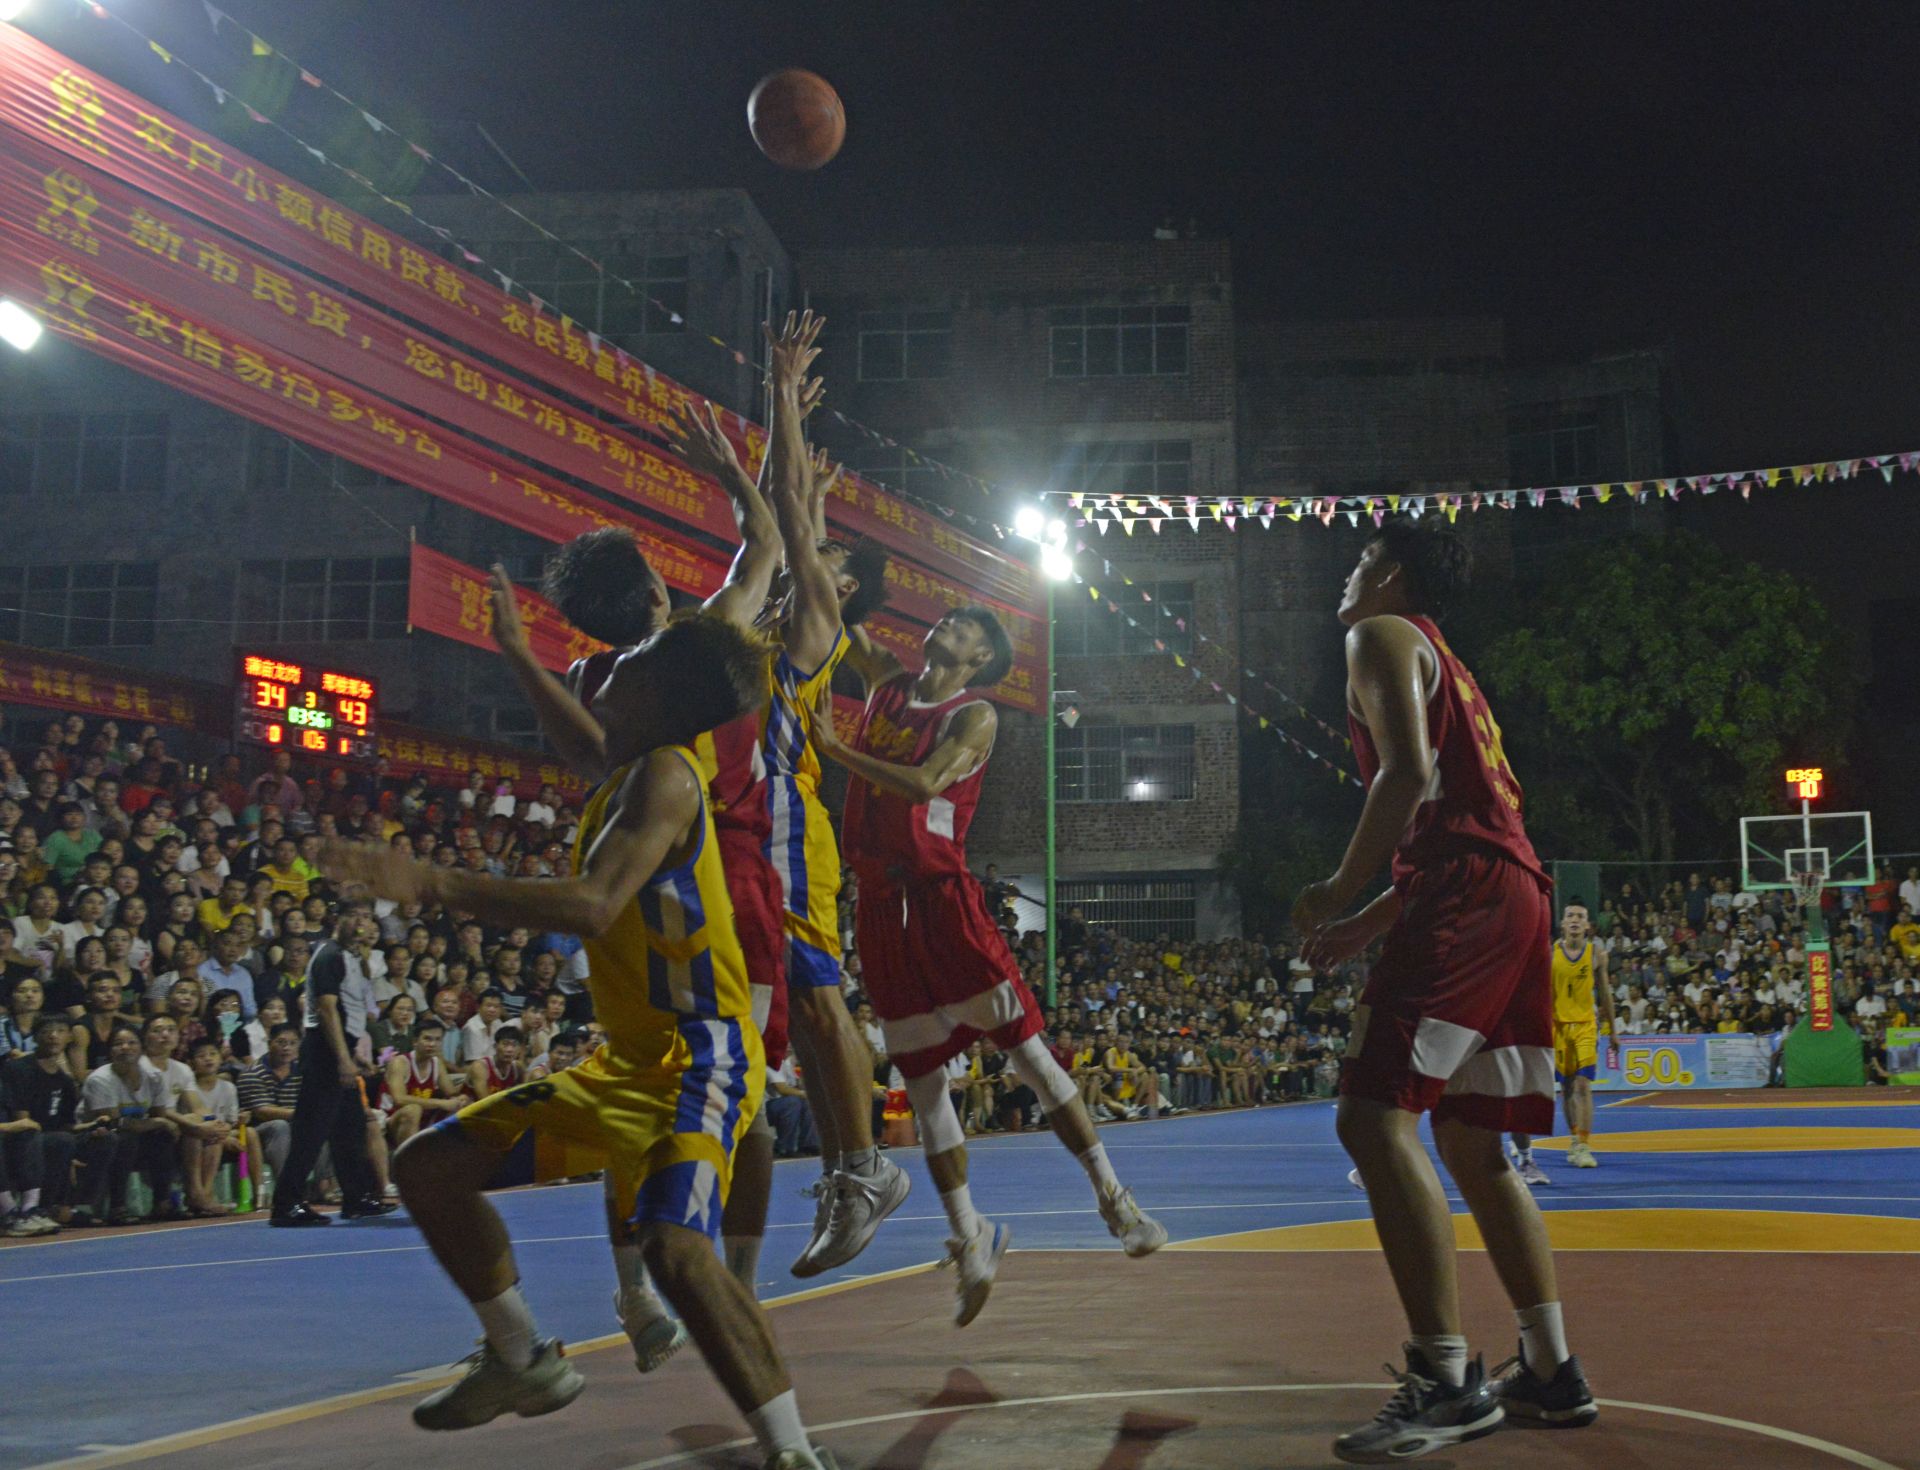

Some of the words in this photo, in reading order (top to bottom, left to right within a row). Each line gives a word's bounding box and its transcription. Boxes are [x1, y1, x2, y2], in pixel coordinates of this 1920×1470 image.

[257, 682, 286, 708] 34
[305, 692, 316, 708] 3
[340, 700, 367, 725] 43
[1800, 781, 1818, 798] 10
[1625, 1048, 1681, 1085] 50
